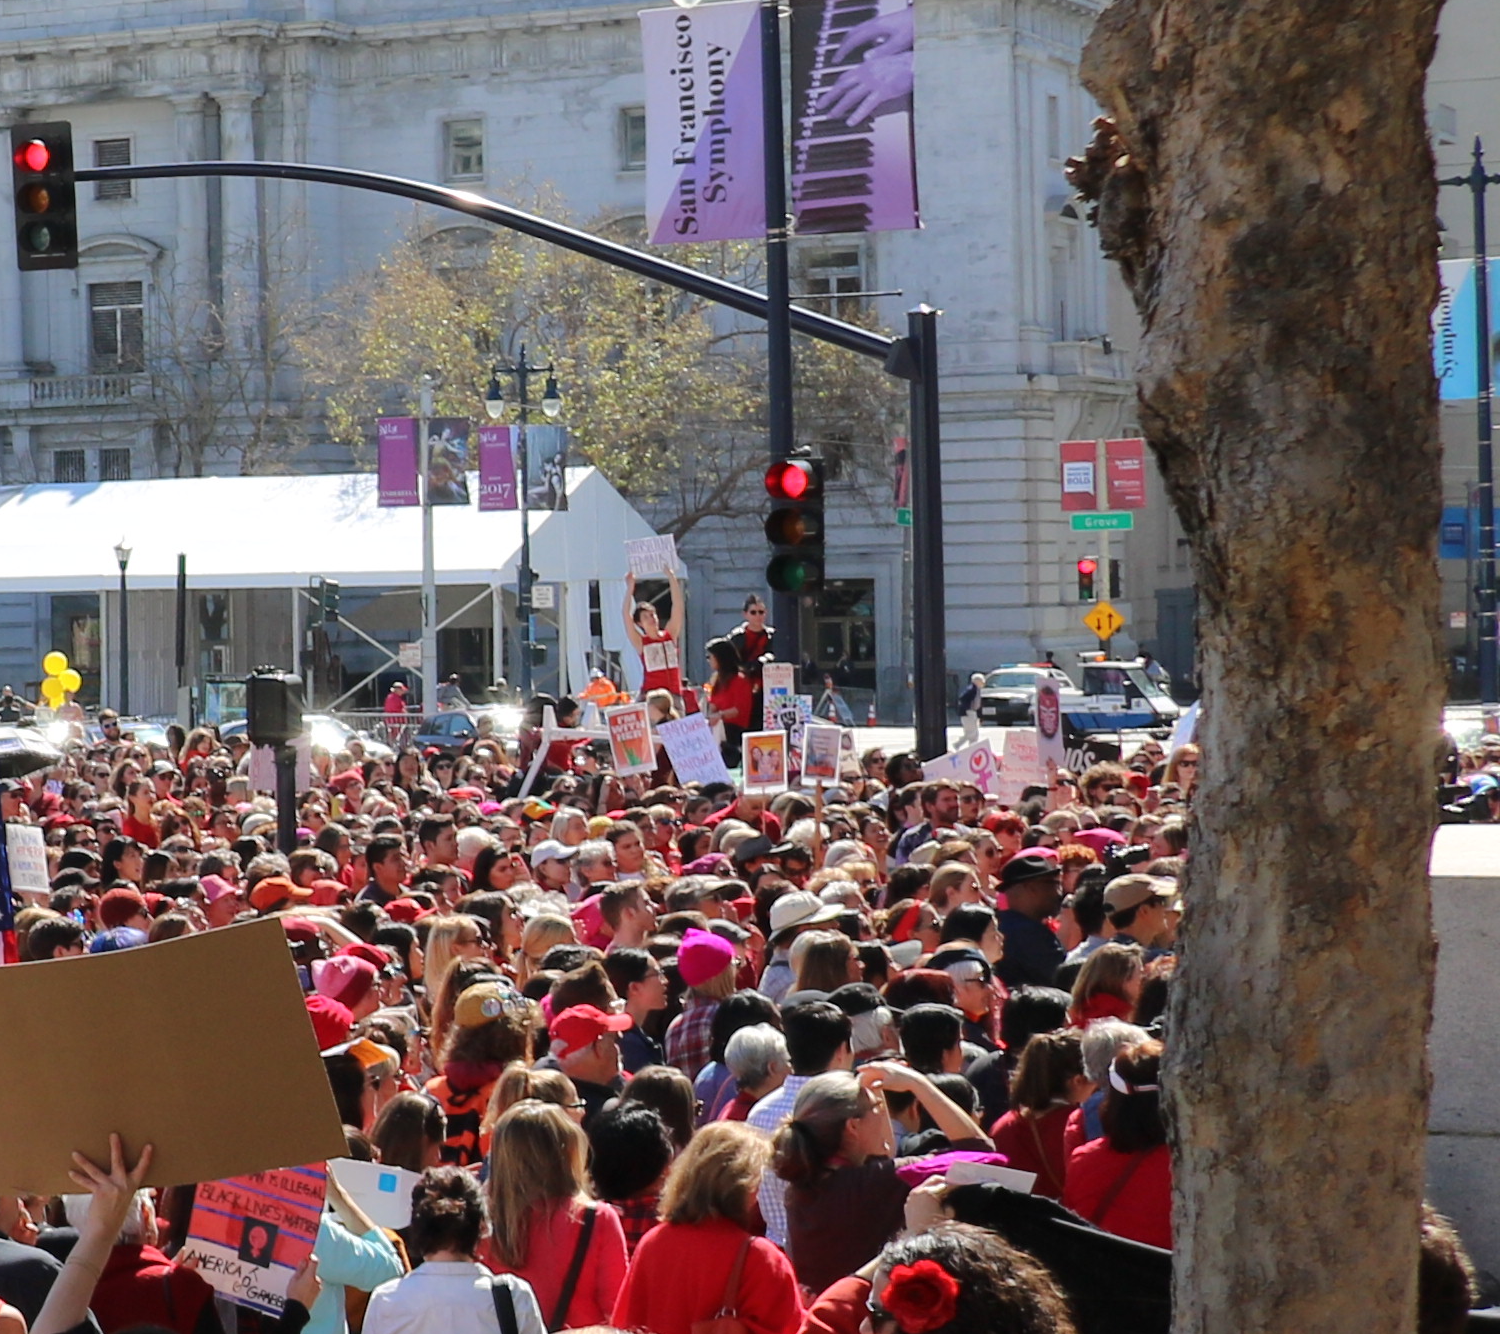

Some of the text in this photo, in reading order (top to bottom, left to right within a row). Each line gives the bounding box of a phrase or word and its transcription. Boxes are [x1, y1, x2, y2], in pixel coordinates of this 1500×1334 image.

[671, 15, 698, 234] San Francisco
[702, 42, 733, 203] Symphony
[480, 483, 511, 498] 2017
[1085, 517, 1118, 527] Grove
[200, 1184, 242, 1210] BLACK
[245, 1199, 282, 1221] LIVES
[183, 1249, 241, 1278] AMERICA
